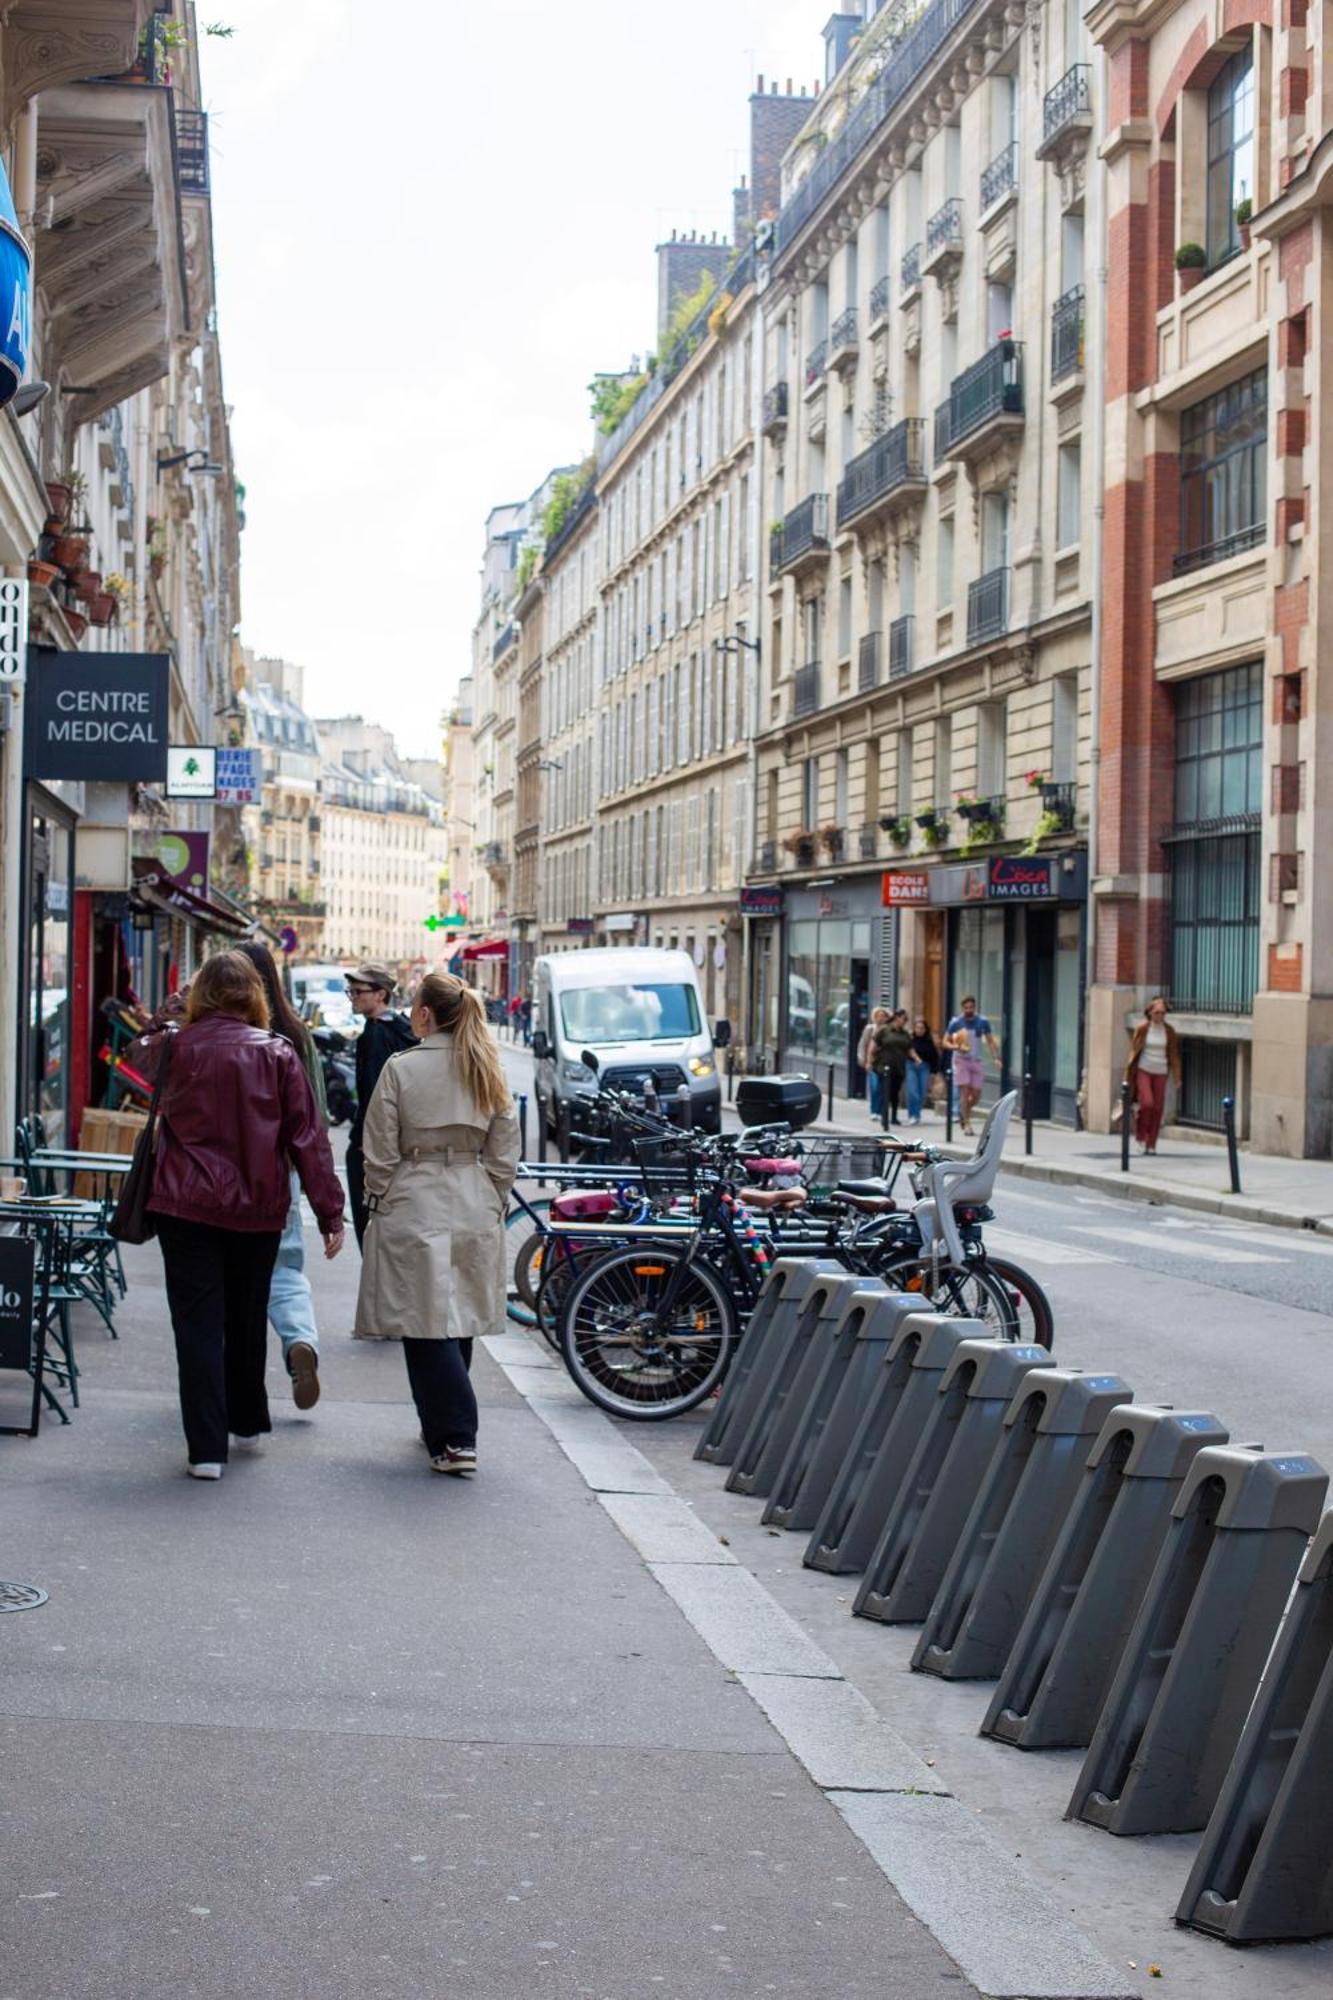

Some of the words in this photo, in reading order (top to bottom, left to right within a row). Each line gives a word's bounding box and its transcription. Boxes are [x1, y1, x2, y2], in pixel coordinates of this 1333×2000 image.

[56, 690, 150, 713] CENTRE
[47, 720, 159, 744] MEDICAL
[889, 875, 924, 886] ECOLE
[991, 883, 1049, 895] IMAGES
